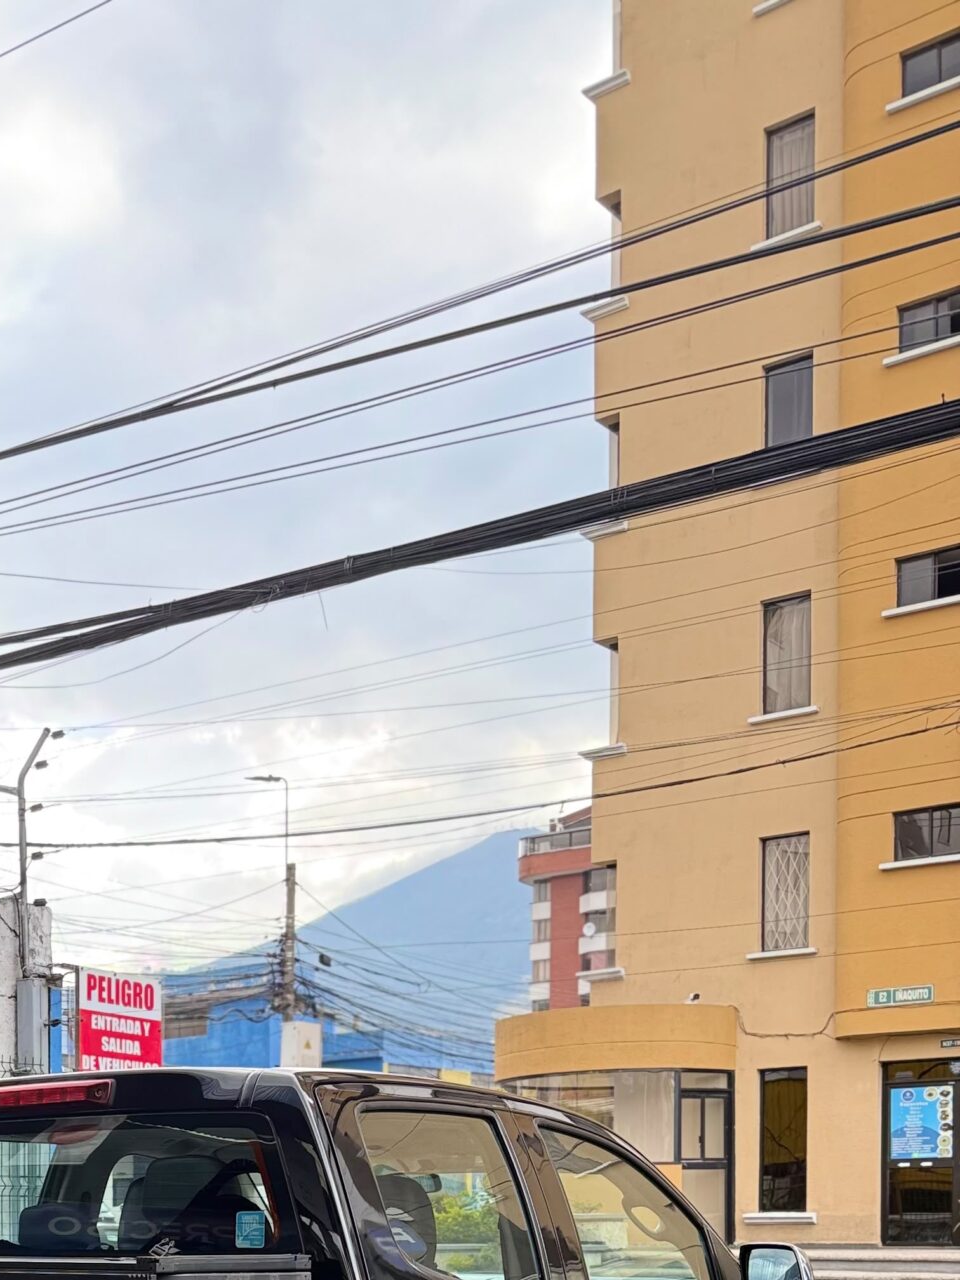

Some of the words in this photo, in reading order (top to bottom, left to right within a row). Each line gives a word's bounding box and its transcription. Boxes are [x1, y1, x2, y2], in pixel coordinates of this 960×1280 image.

[86, 973, 155, 1012] PELIGRO
[878, 991, 888, 1002] E2
[91, 1014, 142, 1036] ENTRADA
[143, 1022, 151, 1037] Y
[101, 1036, 141, 1056] SALIDA
[82, 1054, 97, 1071] DE
